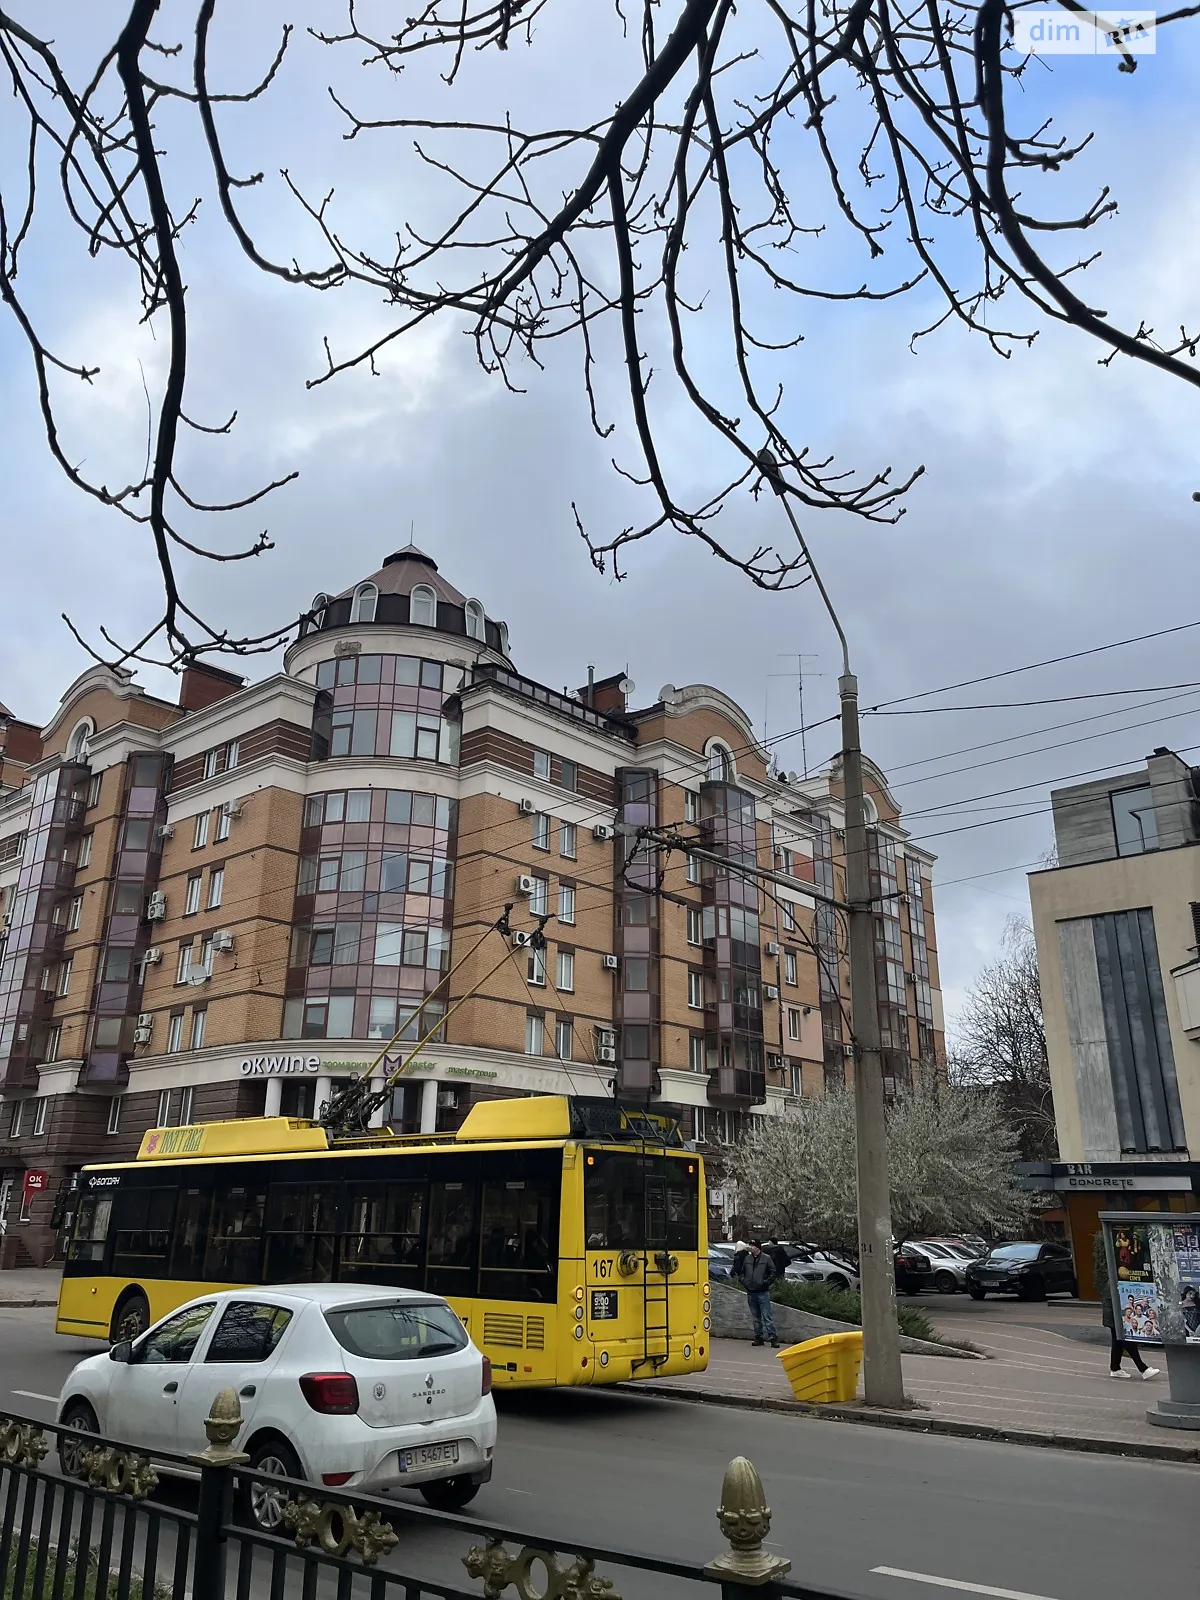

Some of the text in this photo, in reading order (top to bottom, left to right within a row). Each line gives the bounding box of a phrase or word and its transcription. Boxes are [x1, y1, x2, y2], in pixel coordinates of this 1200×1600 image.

[1067, 1164, 1092, 1175] BAR
[29, 1175, 42, 1183] OK
[593, 1259, 613, 1278] 167
[412, 1388, 446, 1398] SANDERO
